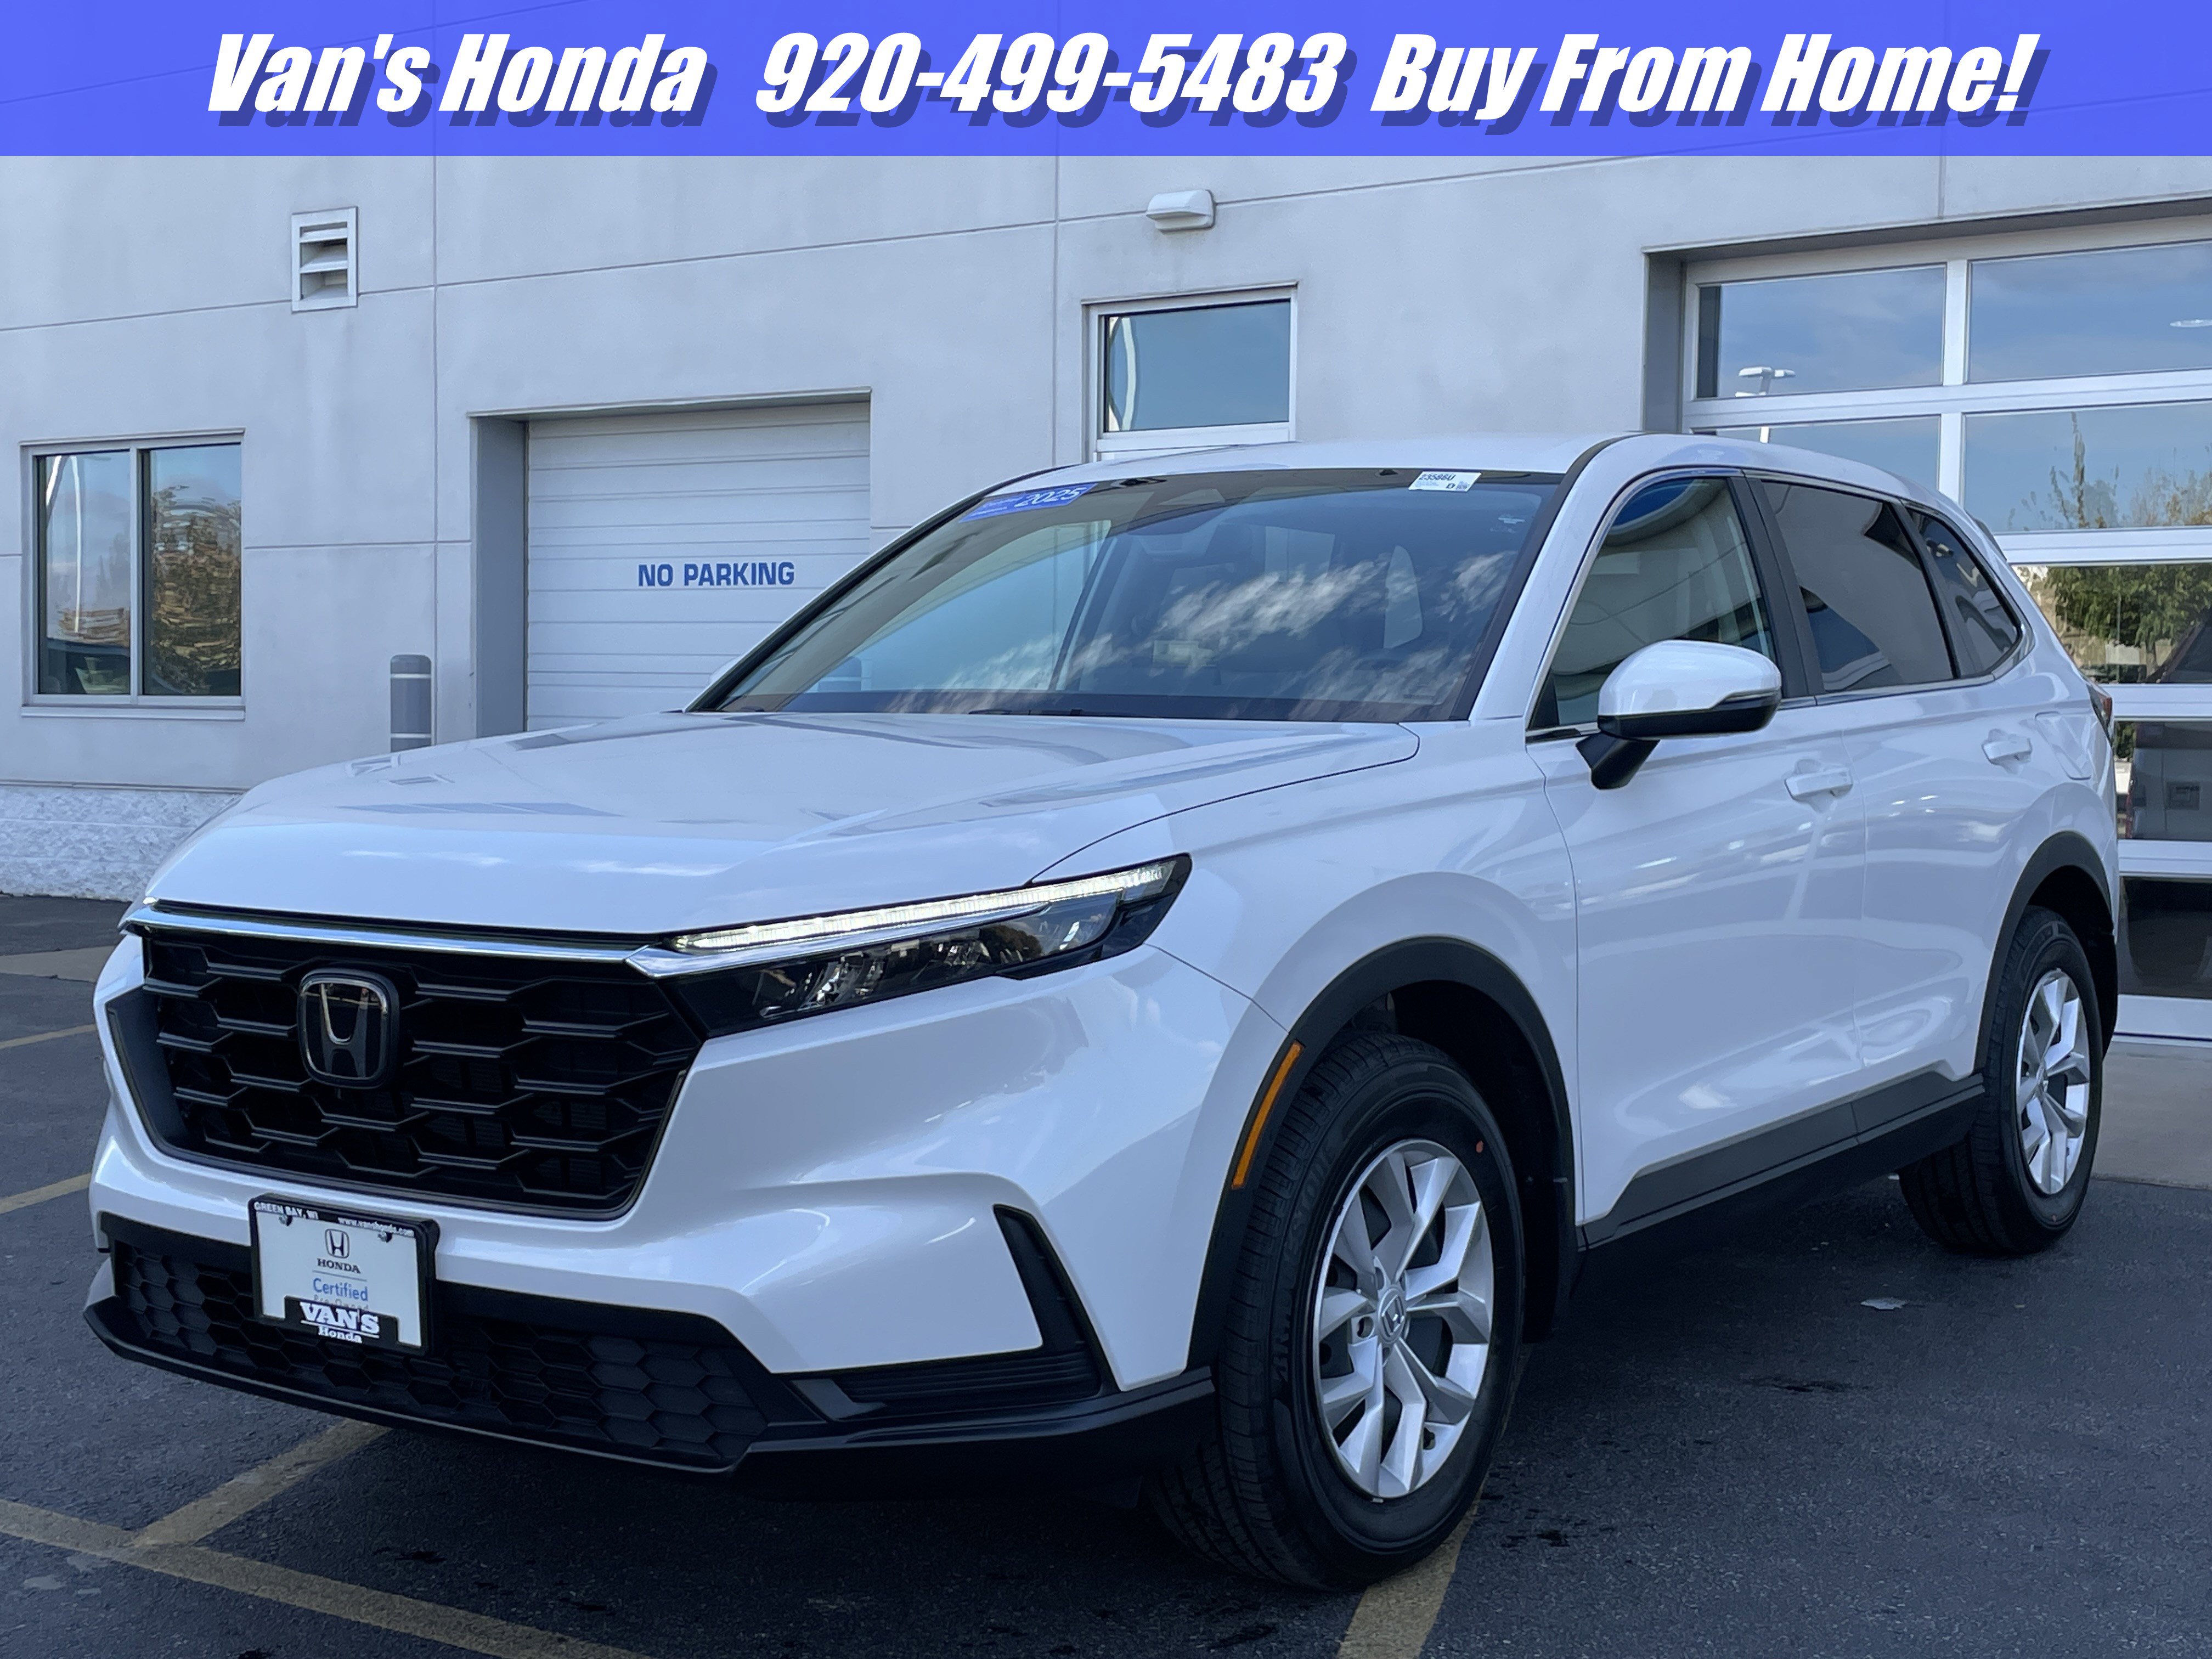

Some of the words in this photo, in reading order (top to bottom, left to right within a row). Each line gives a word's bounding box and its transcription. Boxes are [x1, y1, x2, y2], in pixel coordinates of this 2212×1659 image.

[1014, 487, 1087, 507] 2025
[638, 563, 674, 586] NO
[684, 561, 795, 586] PARKING
[317, 1258, 361, 1273] HONDA
[313, 1277, 369, 1302] Certified
[318, 1325, 363, 1344] Honda
